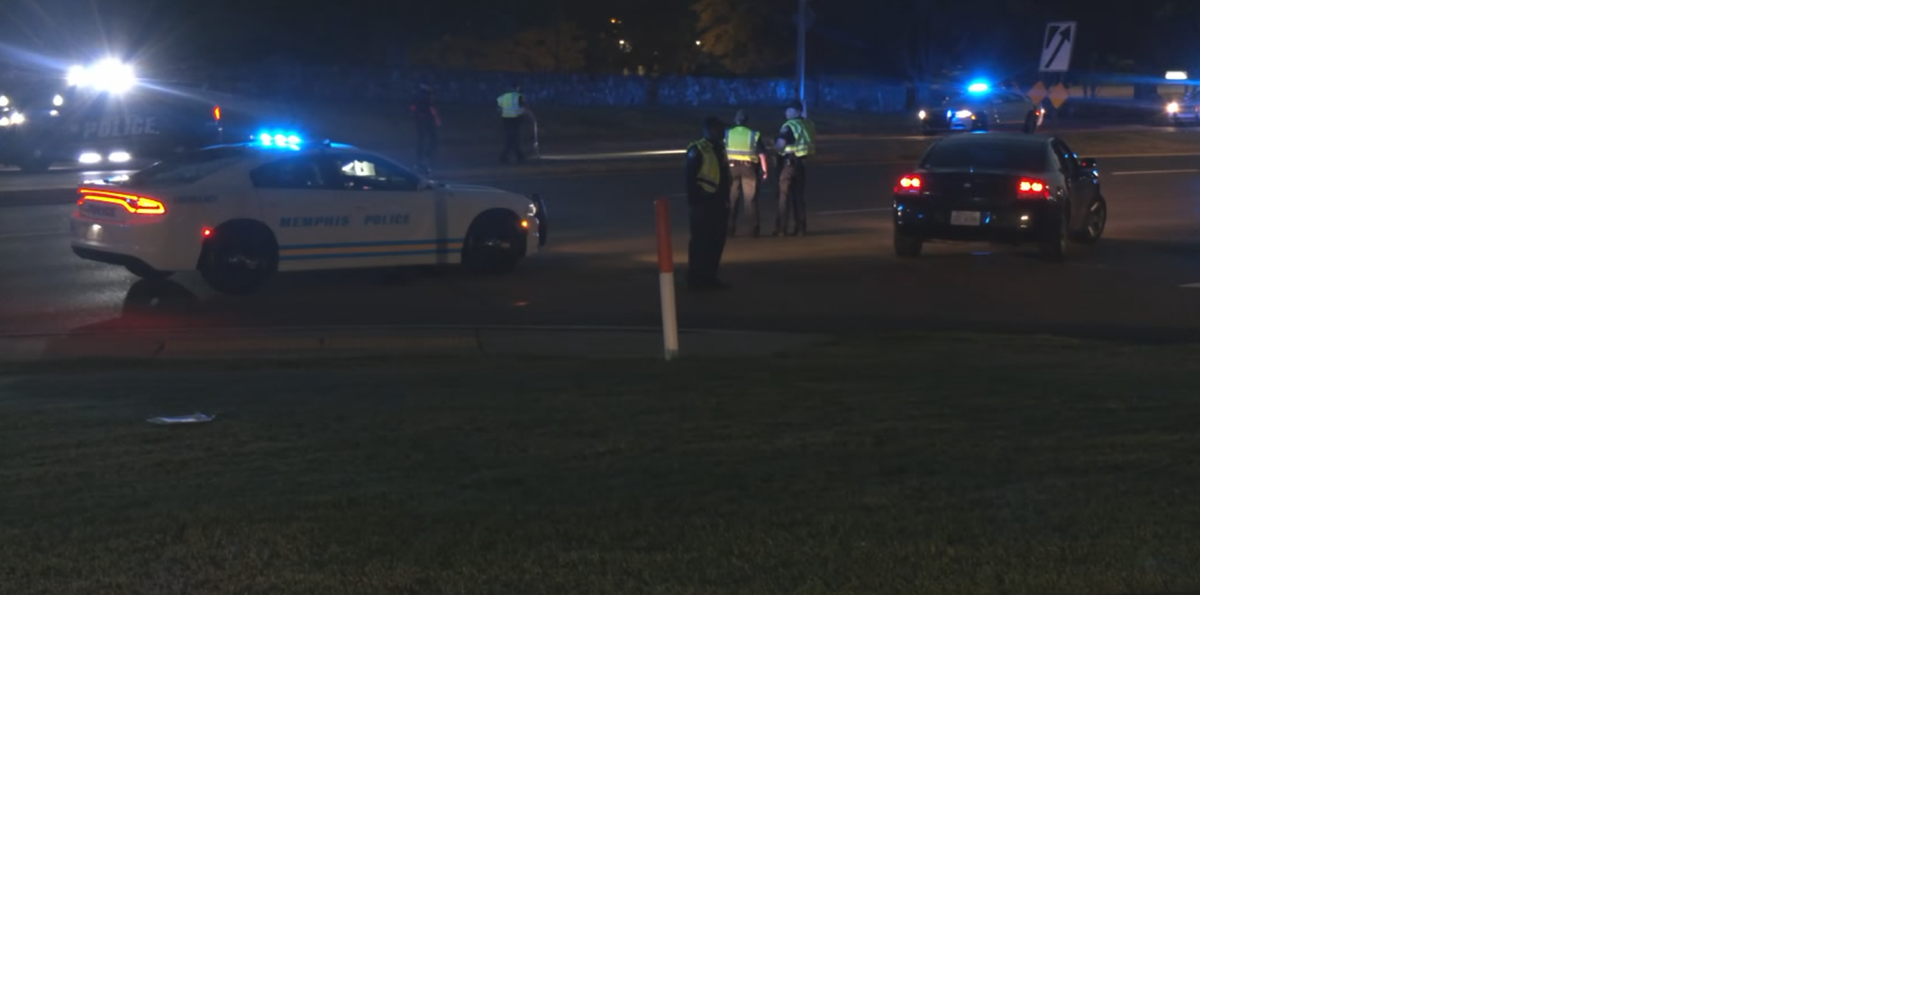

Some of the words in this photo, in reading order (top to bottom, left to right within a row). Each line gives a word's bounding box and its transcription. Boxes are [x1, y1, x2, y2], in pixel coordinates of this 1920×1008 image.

[83, 115, 157, 138] POLICE
[279, 215, 350, 228] MEMPHIS
[364, 213, 410, 226] POLICE
